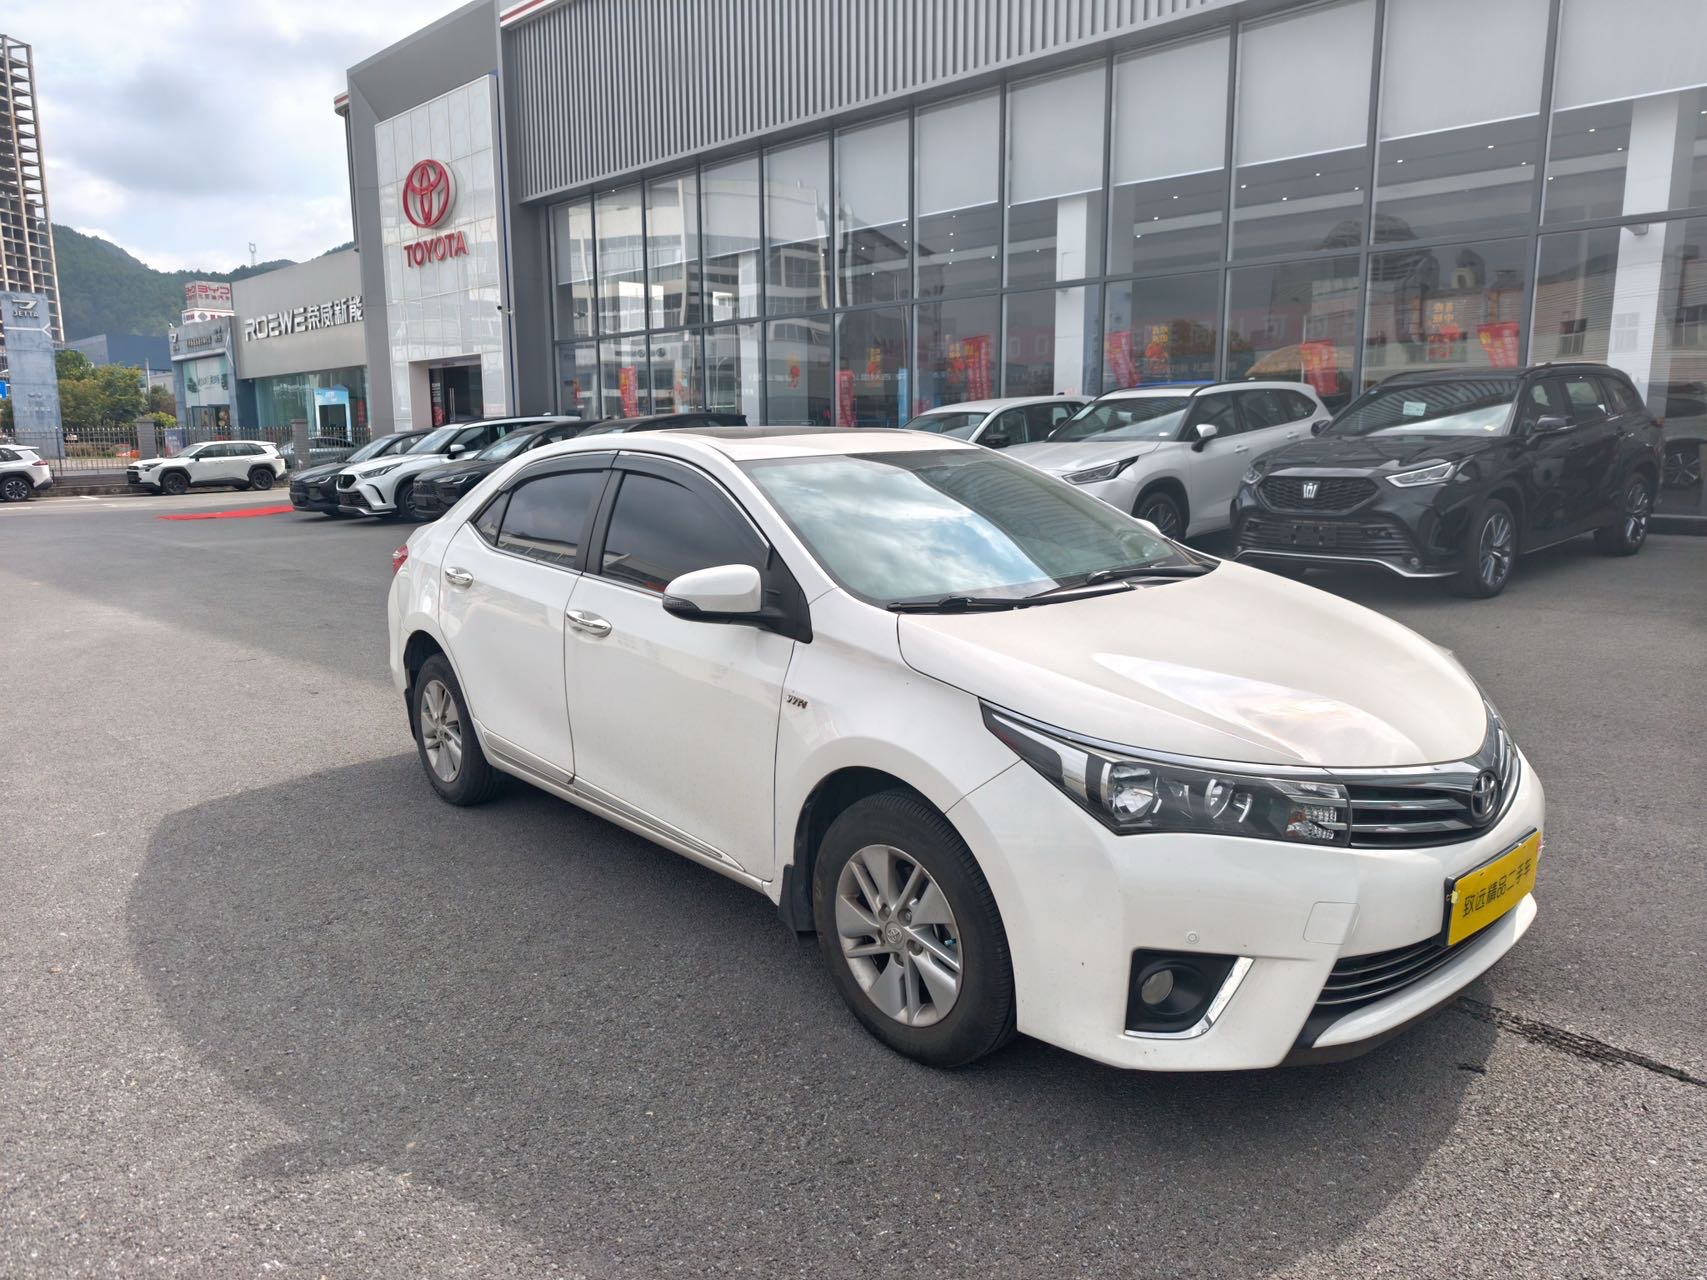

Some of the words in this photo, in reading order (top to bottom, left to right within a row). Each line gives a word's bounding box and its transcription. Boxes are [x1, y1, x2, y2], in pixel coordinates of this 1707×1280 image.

[404, 230, 469, 268] TOYOTA
[13, 310, 39, 318] JETTA
[245, 307, 306, 342] ROEWE
[307, 295, 363, 330] 荣威新能
[1463, 858, 1532, 918] 致远精品二手车
